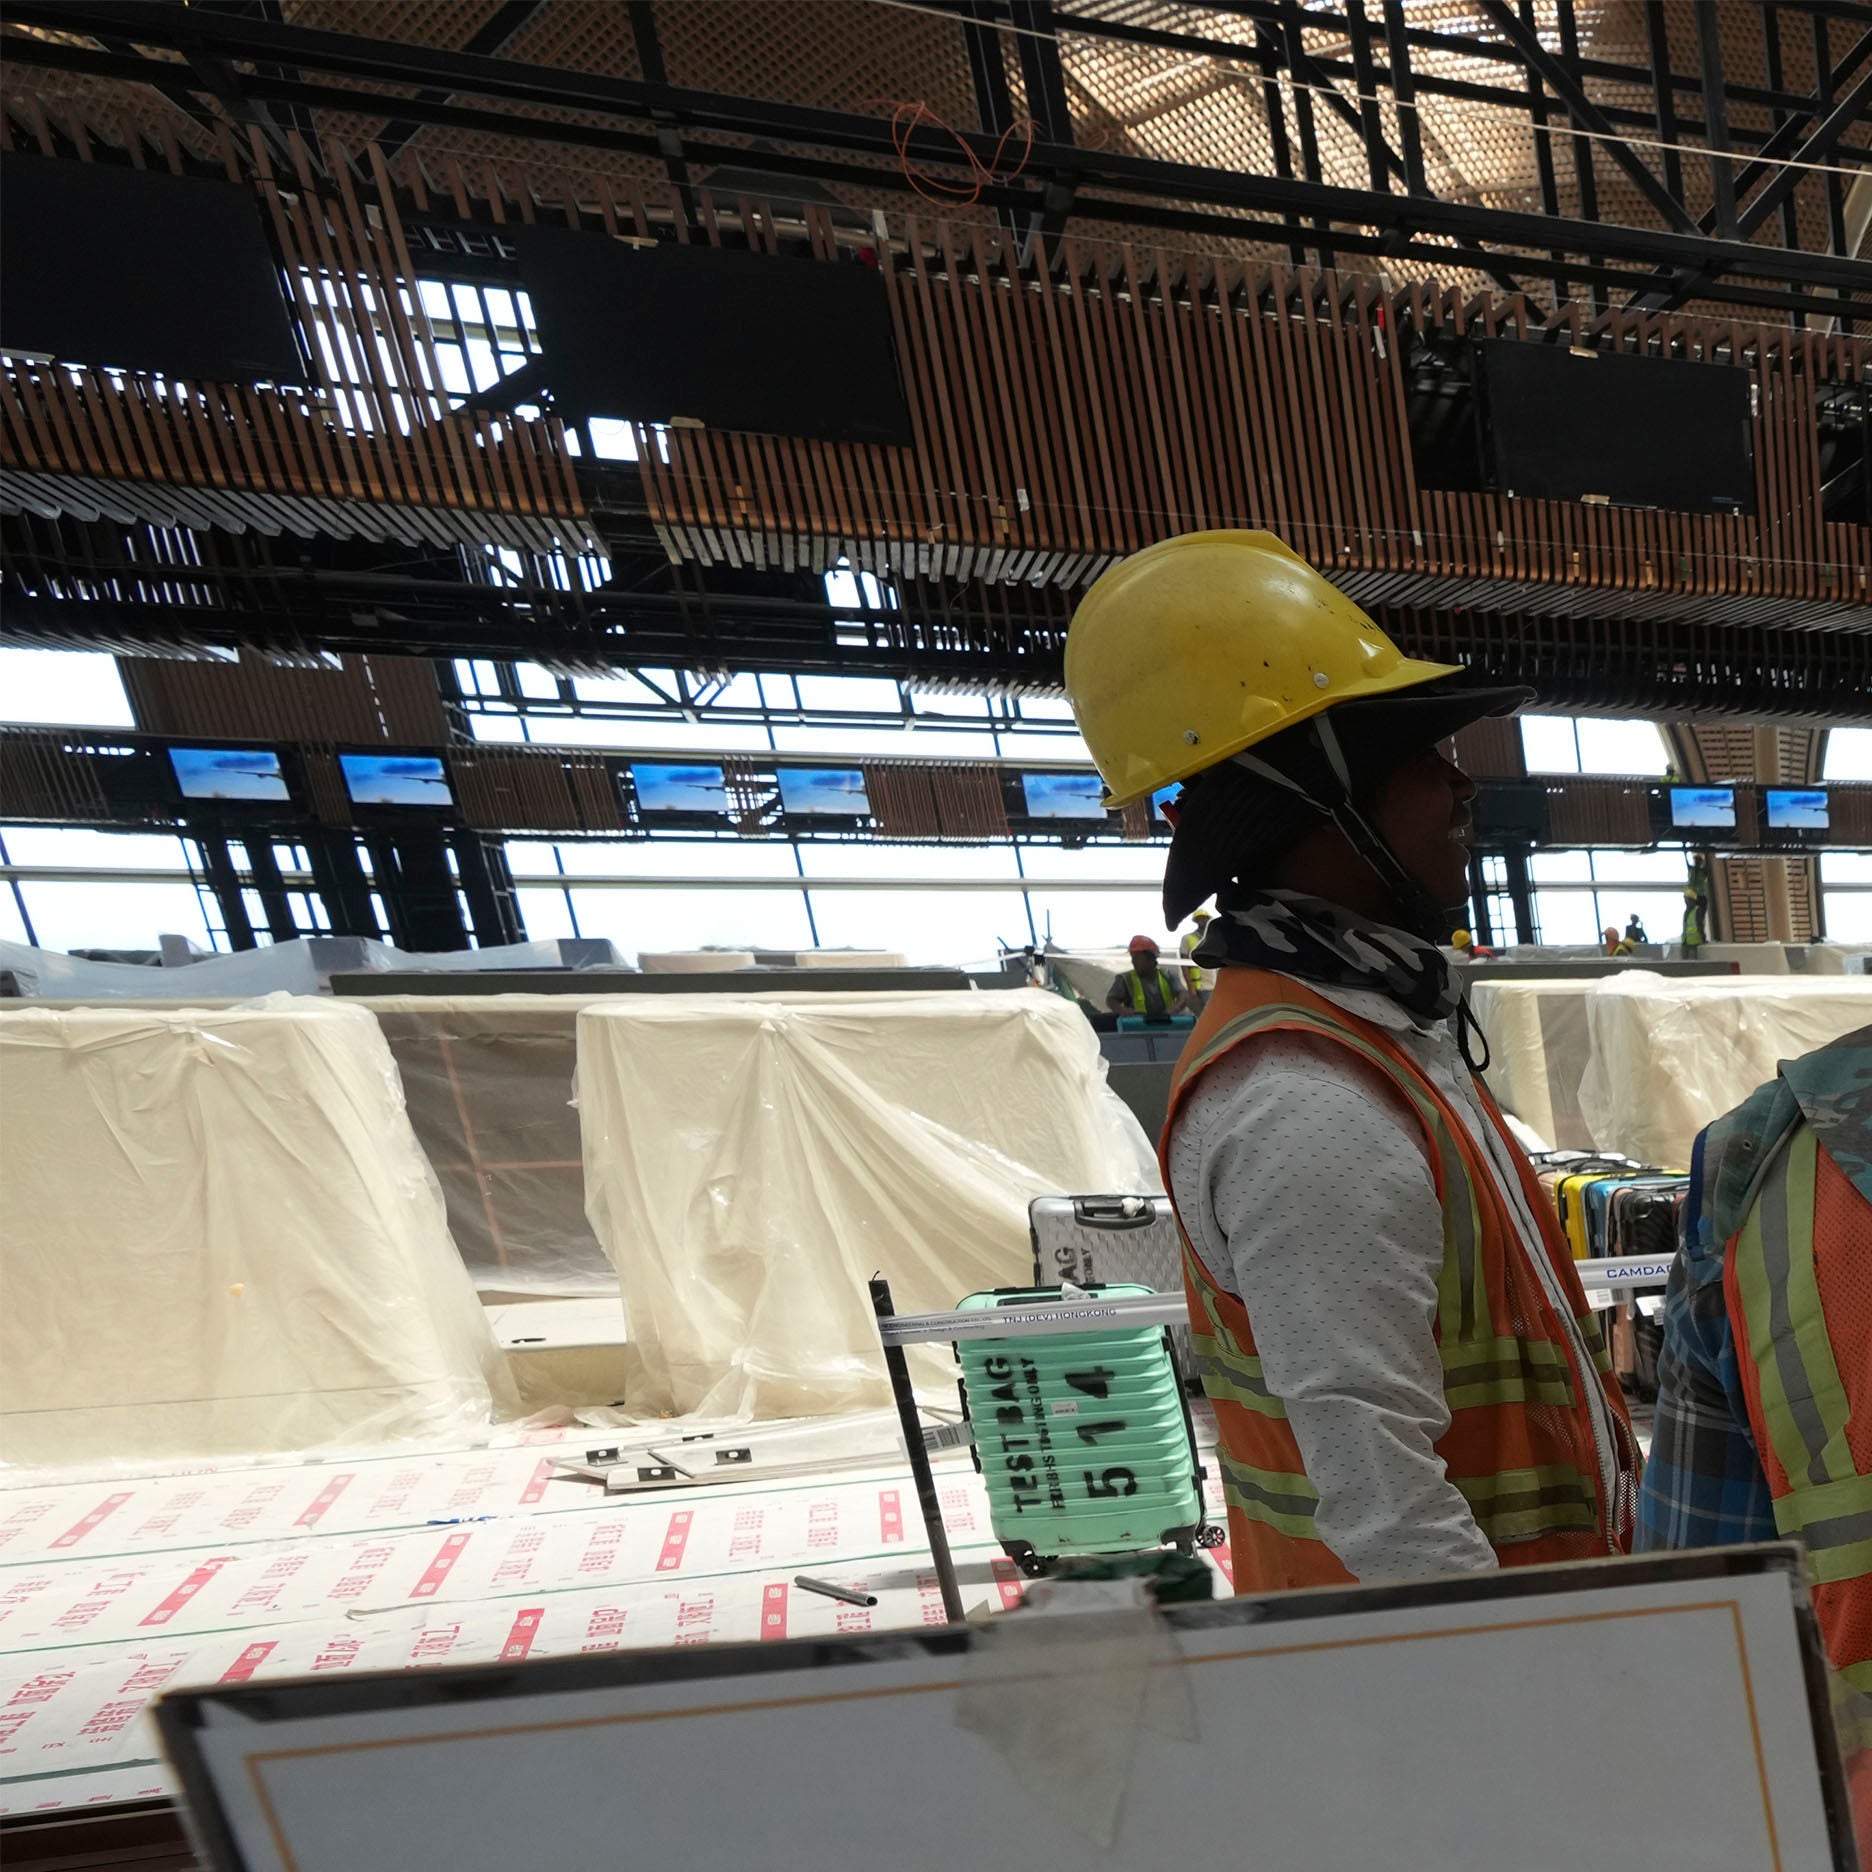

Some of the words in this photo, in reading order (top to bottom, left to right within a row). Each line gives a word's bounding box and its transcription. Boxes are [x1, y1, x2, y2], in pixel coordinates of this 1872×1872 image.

[1001, 1315, 1022, 1324] TNJ
[985, 1357, 1025, 1425] BAG
[1000, 1433, 1042, 1513] TEST
